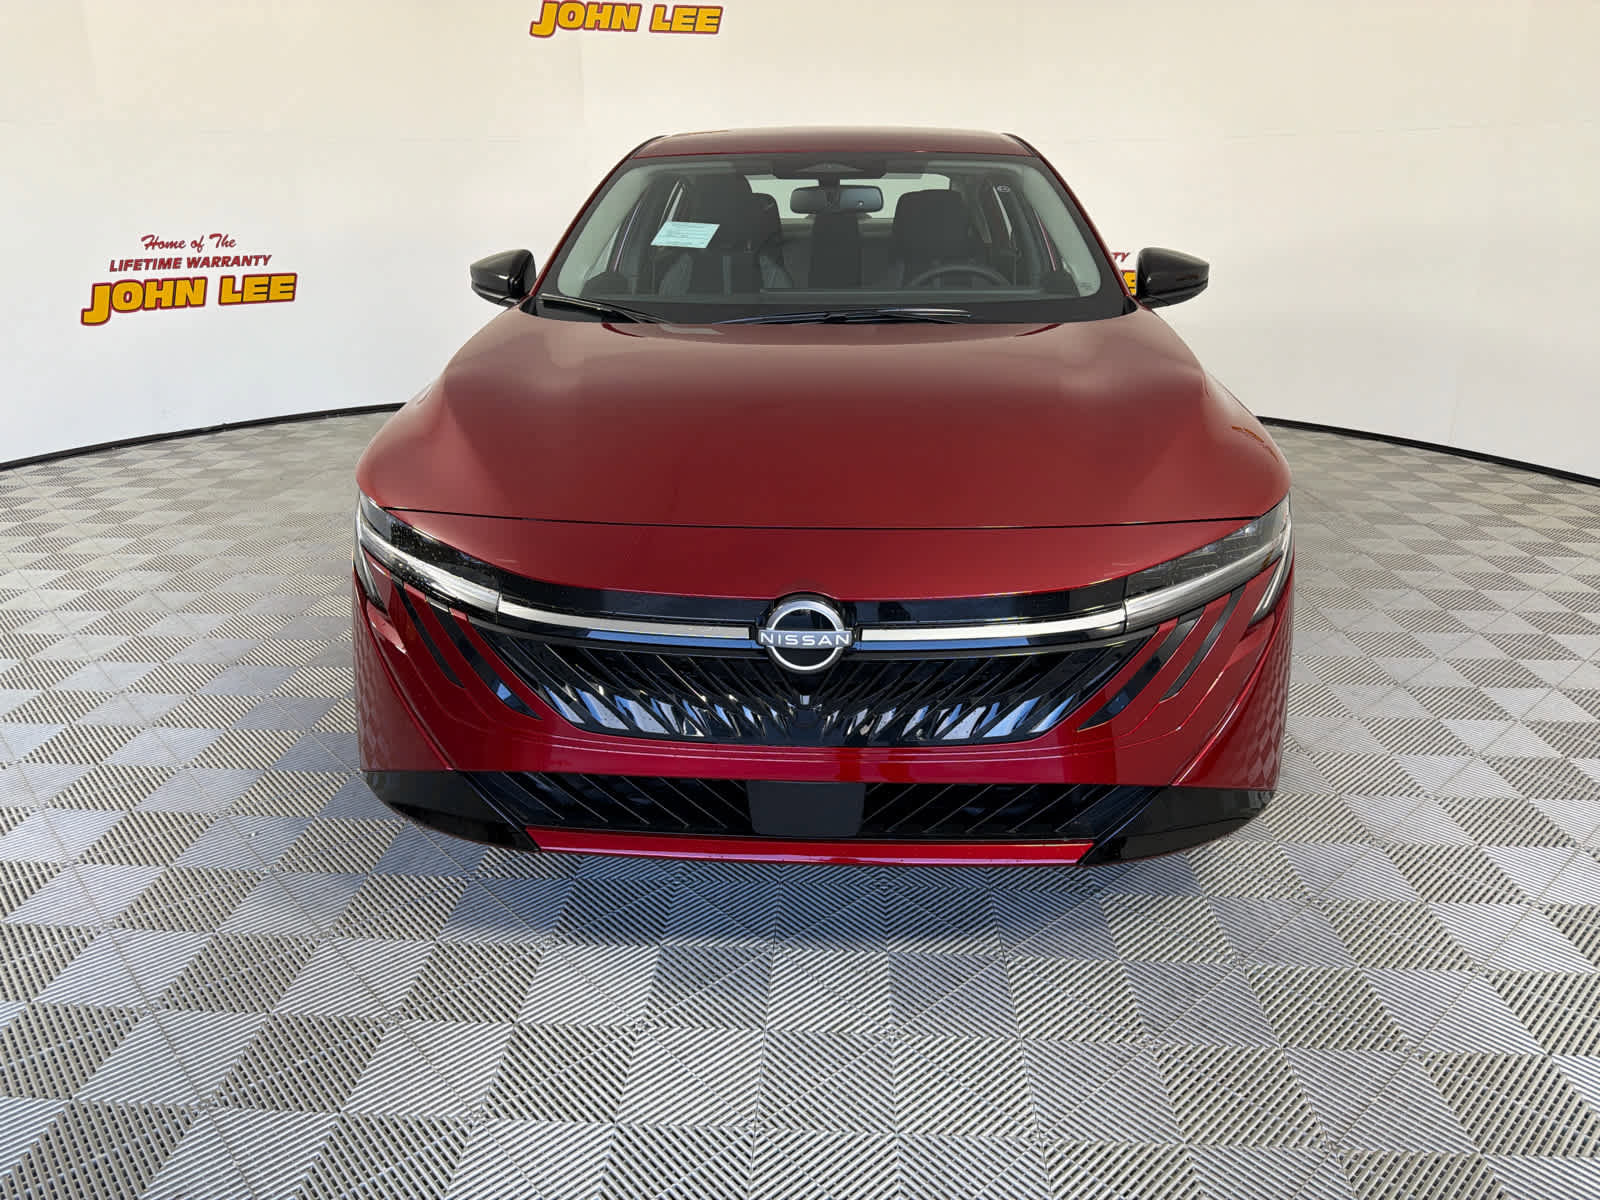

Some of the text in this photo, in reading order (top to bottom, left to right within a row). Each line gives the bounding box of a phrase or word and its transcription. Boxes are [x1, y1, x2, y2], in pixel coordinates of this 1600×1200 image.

[529, 0, 724, 38] JOHN LEE
[141, 233, 236, 253] Home of The
[109, 254, 272, 272] LIFETIME WARRANTY
[81, 273, 298, 326] JOHN LEE
[760, 632, 850, 646] NISSAN
